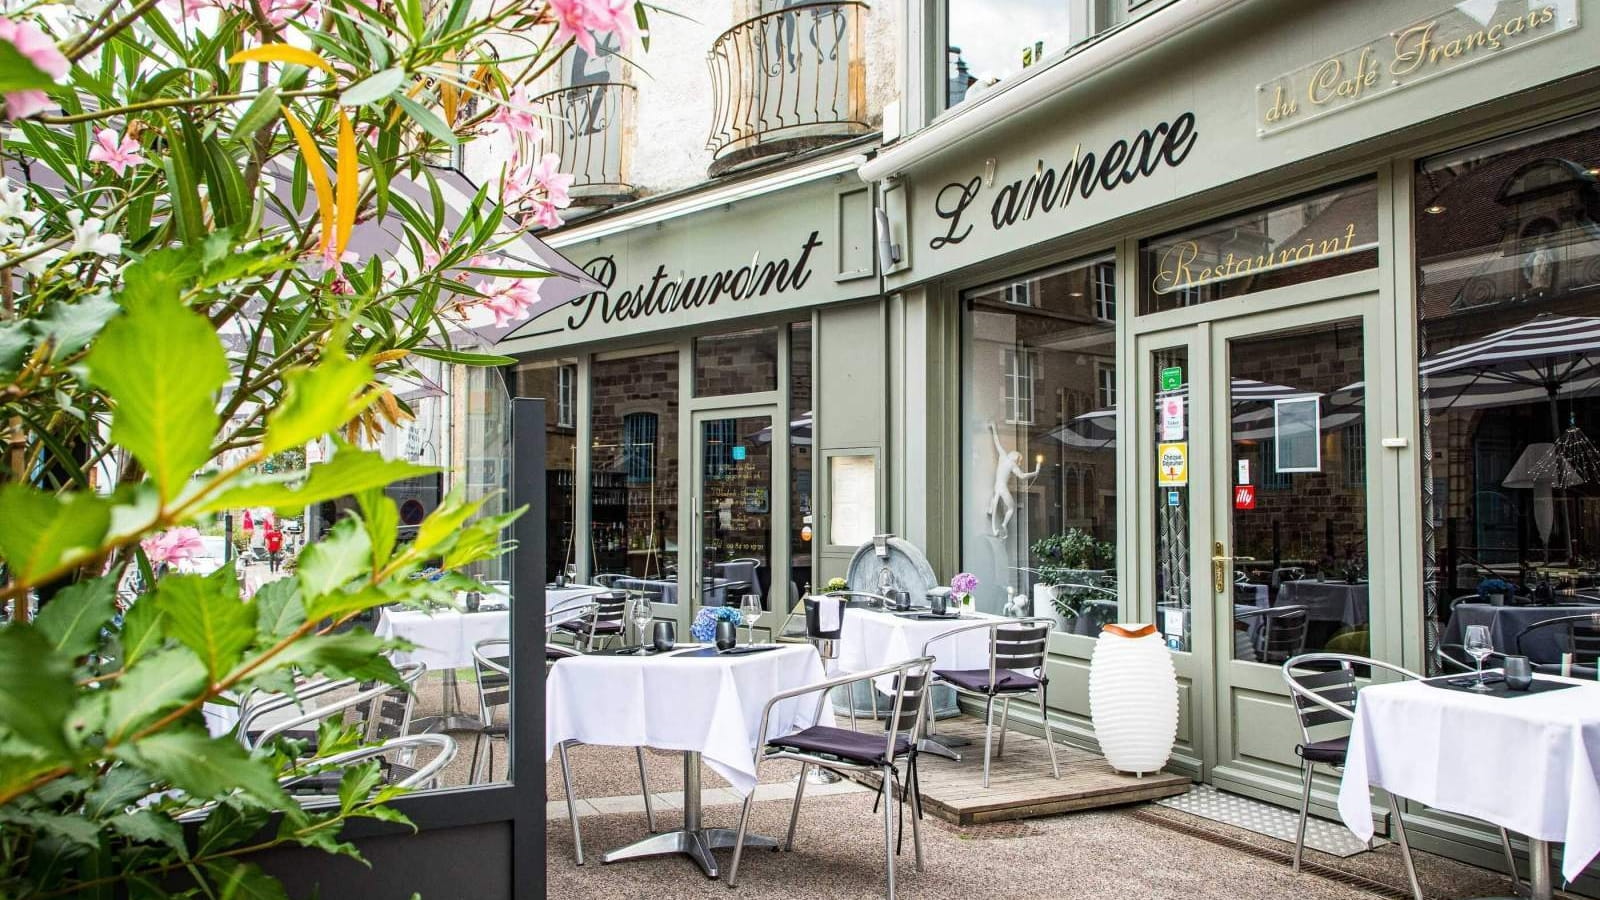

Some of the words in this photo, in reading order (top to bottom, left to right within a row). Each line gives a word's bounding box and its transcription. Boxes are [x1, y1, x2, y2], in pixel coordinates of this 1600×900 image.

[1263, 86, 1298, 124] du
[1307, 46, 1379, 107] Café
[1389, 4, 1555, 77] Français
[568, 230, 823, 329] Restaurant
[1152, 223, 1356, 296] Restaurant
[1236, 488, 1252, 505] illy
